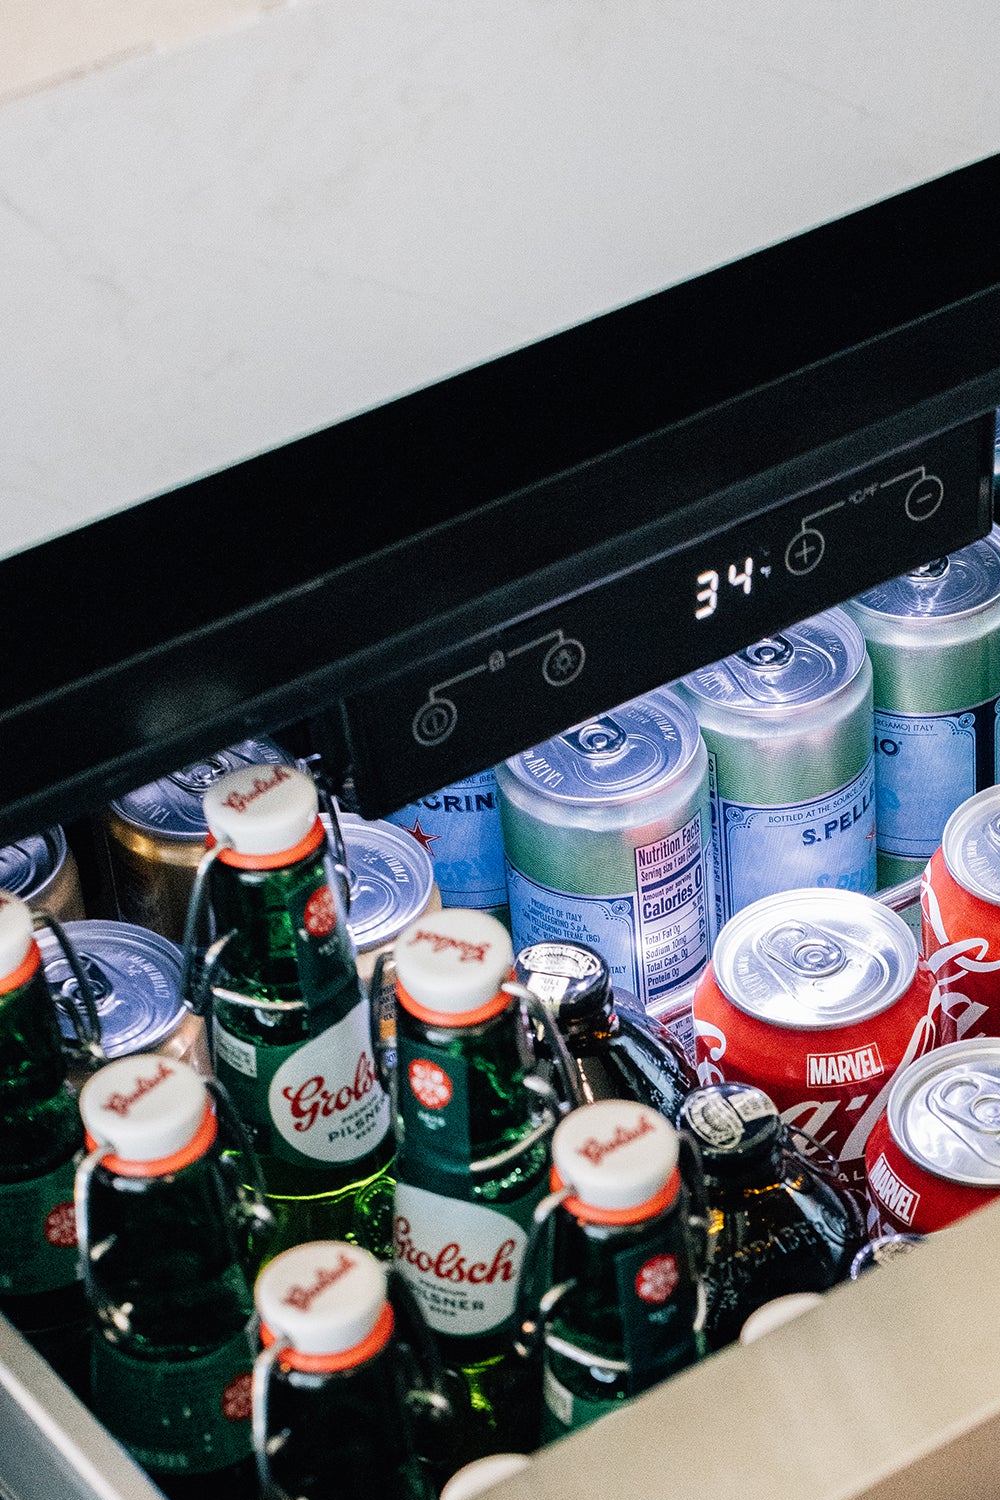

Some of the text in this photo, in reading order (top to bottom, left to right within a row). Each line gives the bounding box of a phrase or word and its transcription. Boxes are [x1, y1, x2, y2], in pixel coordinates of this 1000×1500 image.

[695, 556, 754, 620] 34
[913, 724, 934, 732] ITALY
[768, 813, 803, 823] BOTTLED
[805, 809, 816, 819] AT
[818, 804, 830, 814] THE
[638, 818, 700, 867] Nutrition Facts
[641, 867, 662, 882] Serving
[663, 861, 673, 874] size
[673, 858, 677, 868] 1
[643, 872, 692, 902] Amount per serving
[643, 863, 702, 919] Calories 0
[530, 896, 582, 922] PRODUCT OF ITALY
[564, 930, 583, 941] TERME
[586, 933, 601, 943] (BG)
[645, 924, 680, 945] Total Fat 0g
[646, 935, 687, 959] Sodium 10mg
[610, 966, 626, 975] TALY
[647, 947, 688, 973] Total Carb. 0g
[647, 966, 679, 987] Protein 0g
[809, 1047, 882, 1087] MARVEL
[282, 1051, 376, 1132] Grols
[869, 1157, 918, 1223] MARVEL
